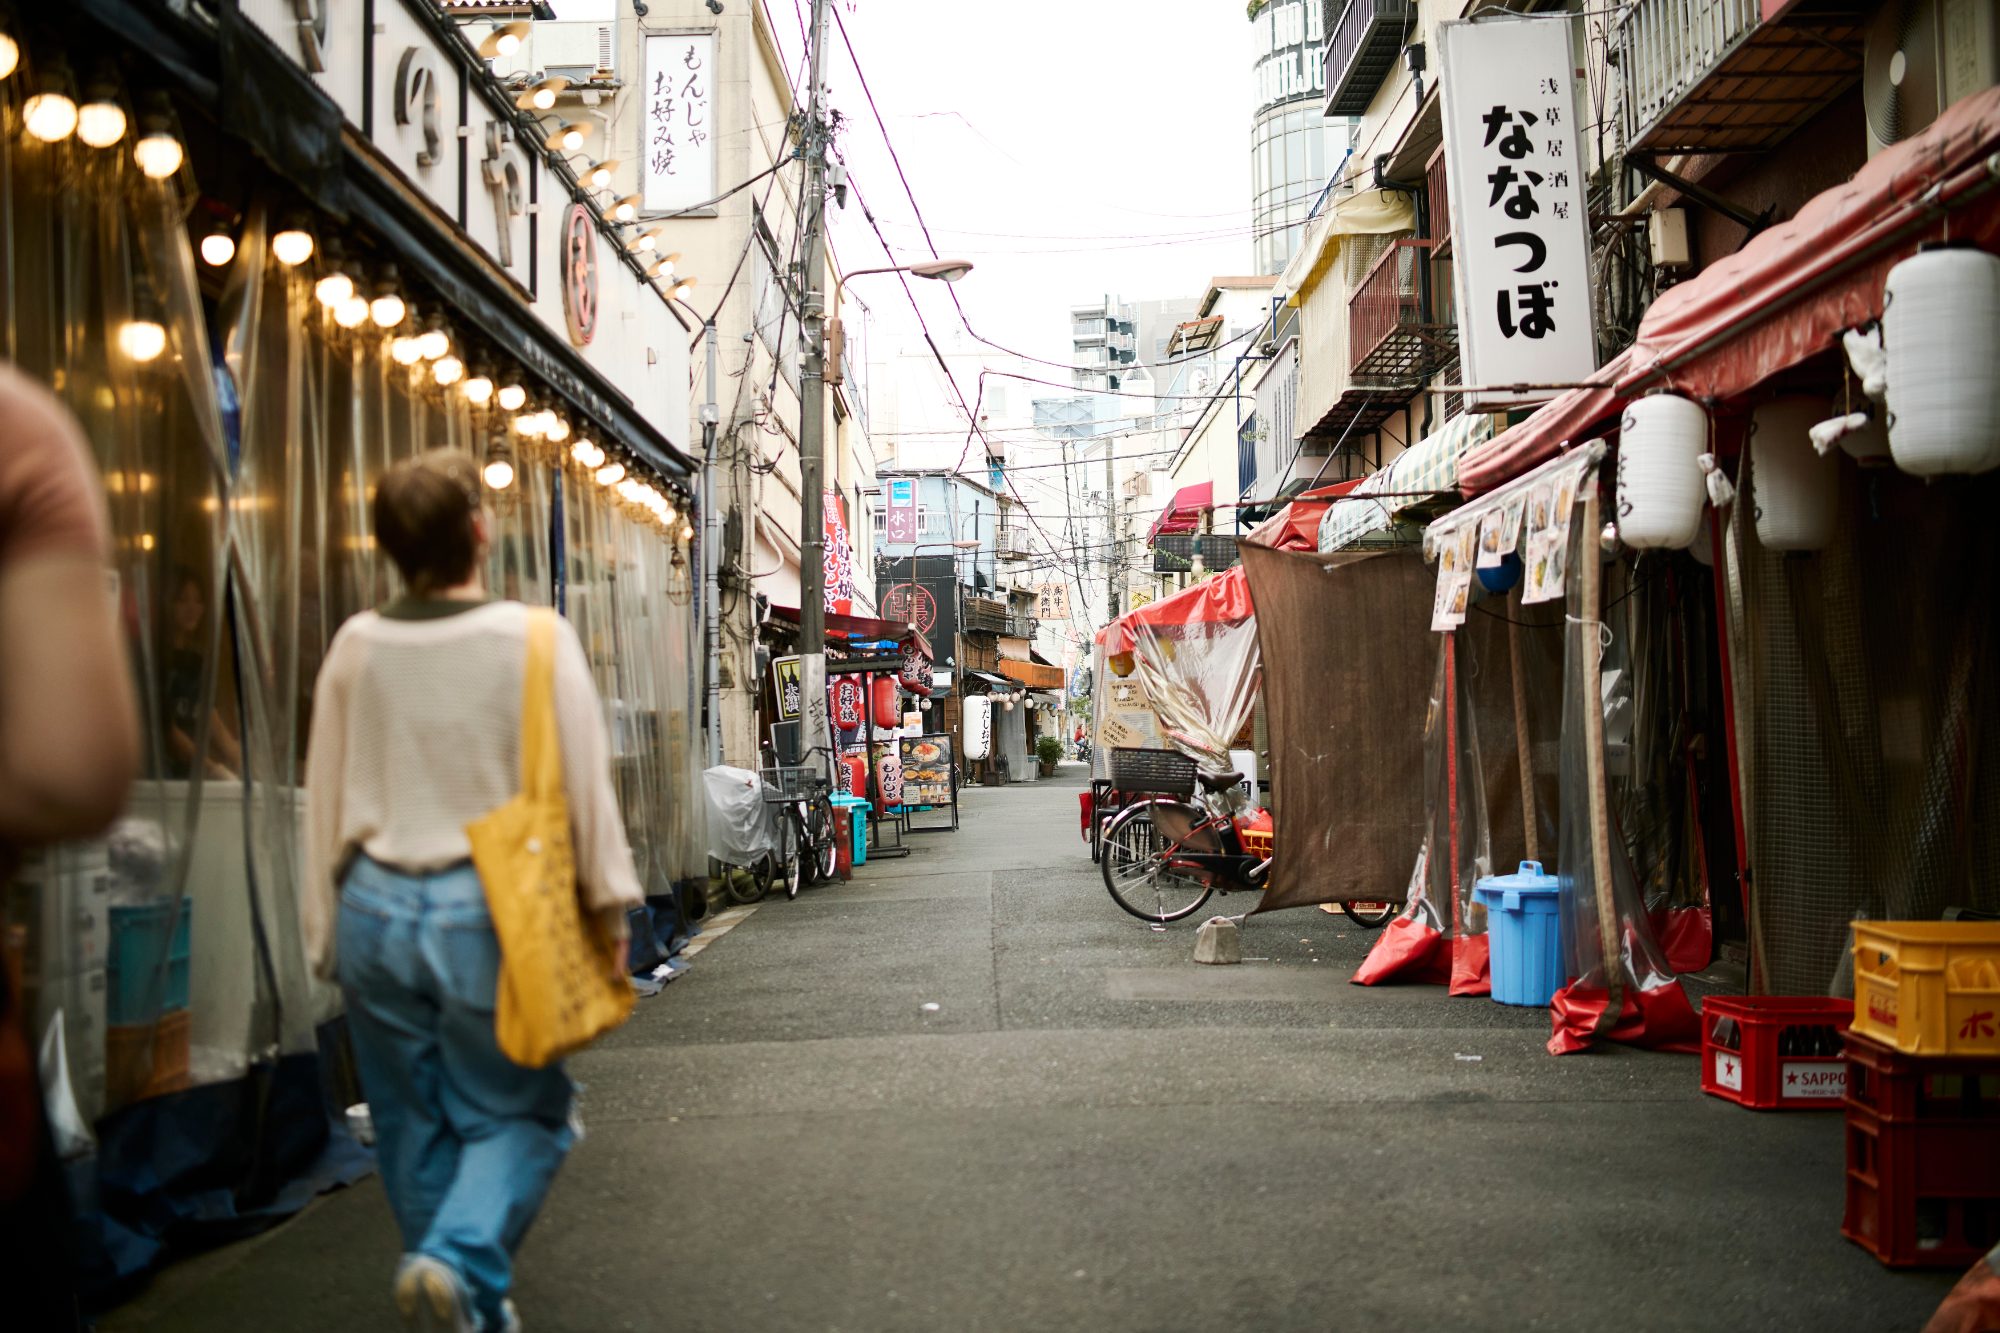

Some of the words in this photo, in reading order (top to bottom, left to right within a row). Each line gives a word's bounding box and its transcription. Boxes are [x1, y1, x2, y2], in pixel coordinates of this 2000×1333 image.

[681, 45, 708, 148] もんじゃ
[651, 71, 676, 176] お好み焼
[1540, 77, 1569, 219] 浅草居酒屋
[1482, 104, 1558, 340] ななつぼ
[890, 511, 905, 538] 水口
[840, 684, 854, 721] お好焼
[979, 699, 990, 758] 牛だしおでん
[841, 764, 853, 795] 鉄板
[882, 763, 896, 799] もんじゃ
[1959, 1010, 2000, 1040] ホ
